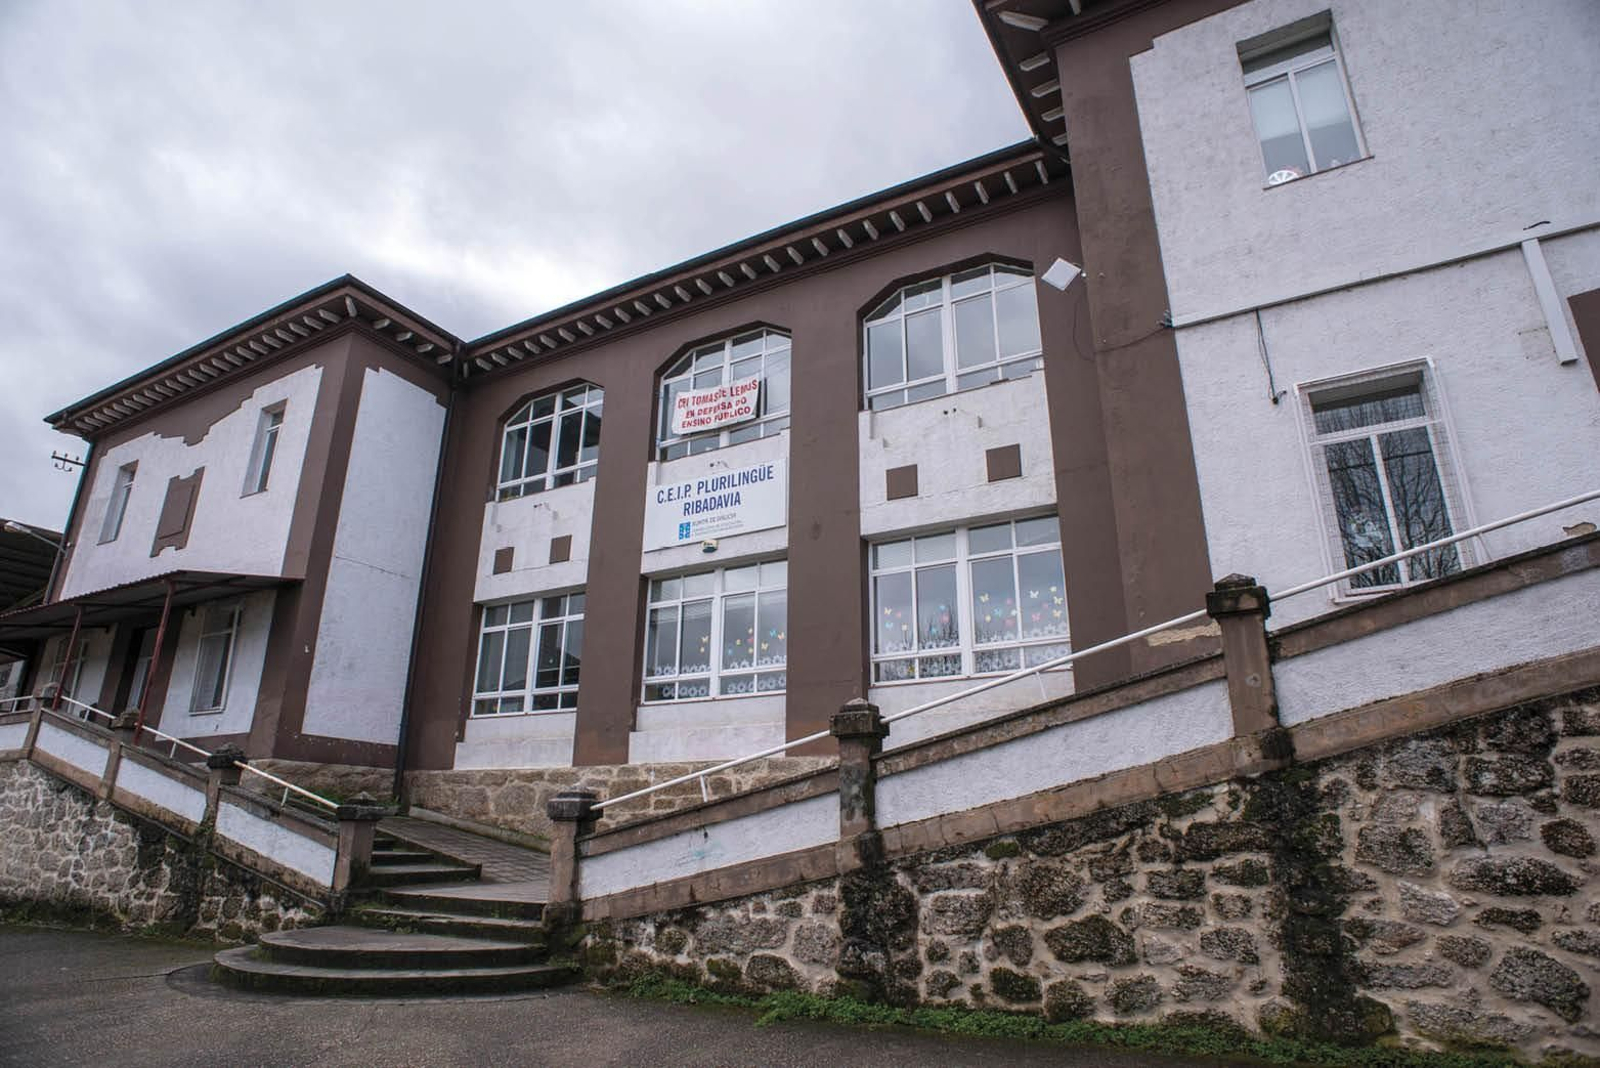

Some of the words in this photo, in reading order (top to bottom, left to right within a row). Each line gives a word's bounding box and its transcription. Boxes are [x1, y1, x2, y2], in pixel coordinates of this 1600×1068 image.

[697, 402, 732, 416] DEFENSA
[735, 396, 747, 407] DO
[682, 417, 711, 428] ENSINO
[657, 484, 692, 504] C.E.I.P.
[697, 464, 774, 496] PLURILINGÜE
[683, 491, 742, 517] RIBADAVIA
